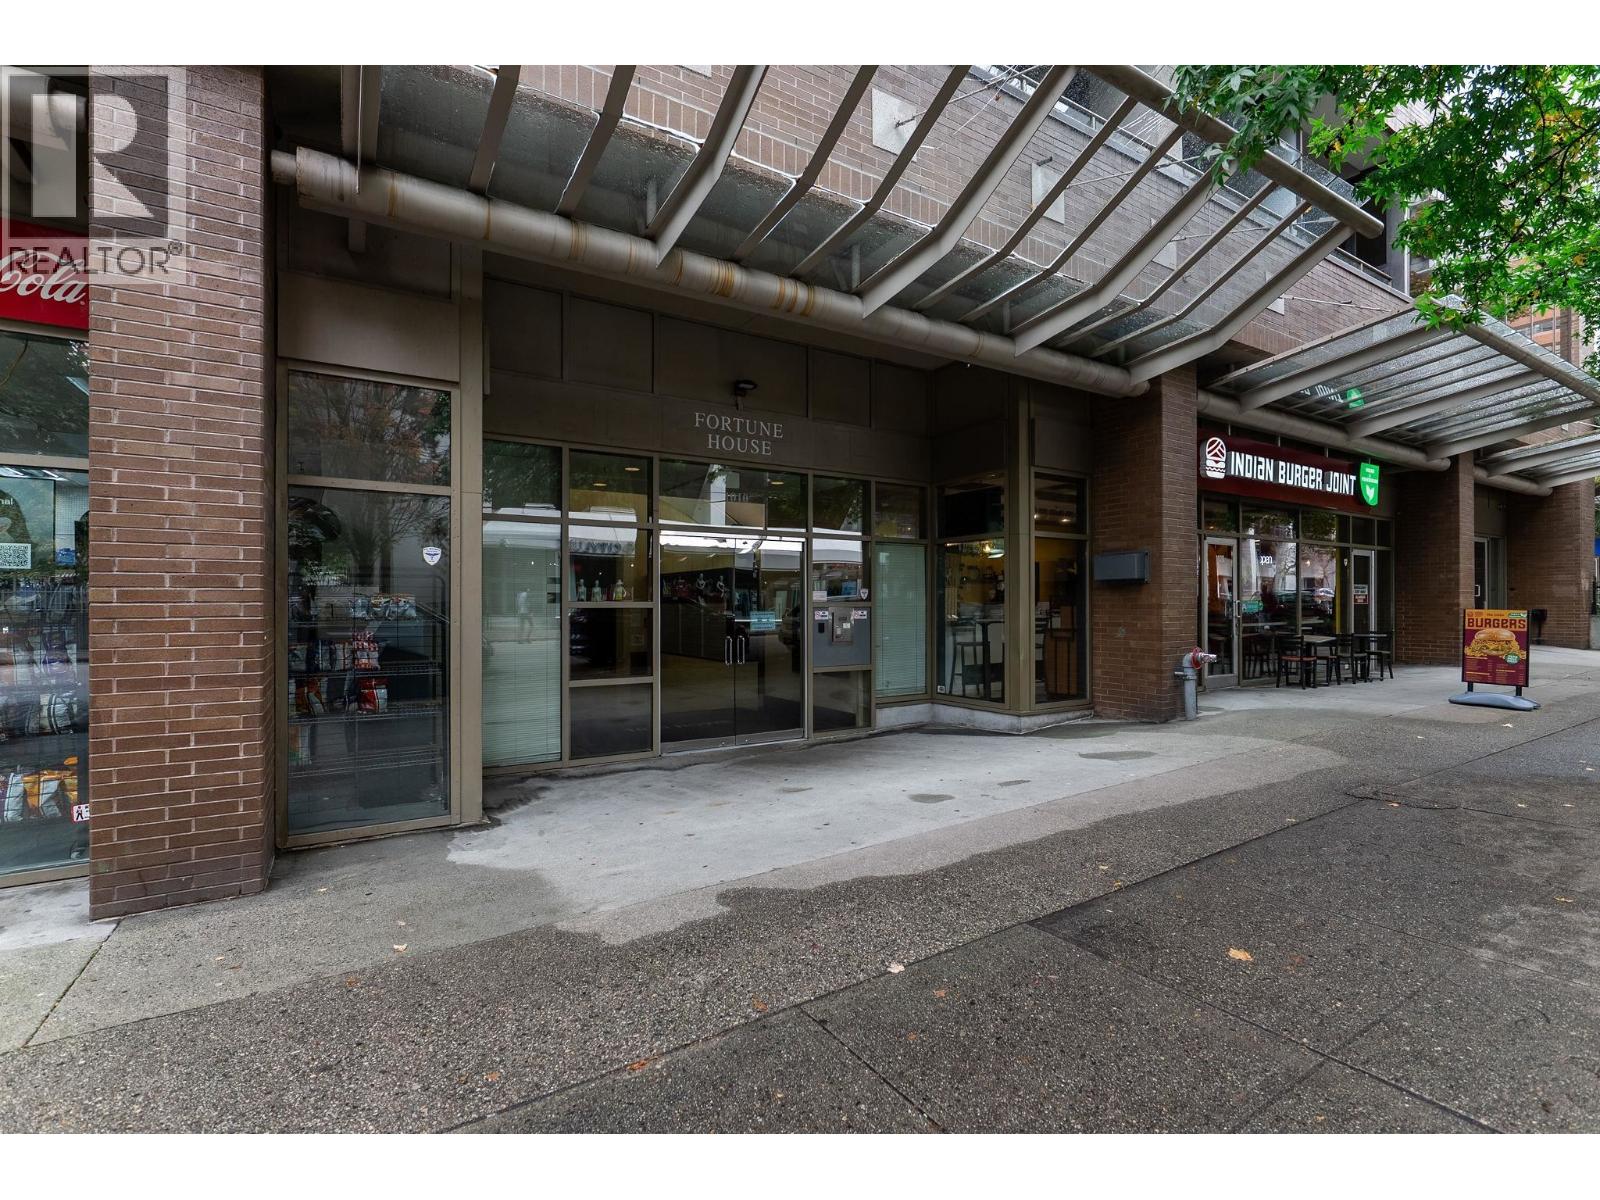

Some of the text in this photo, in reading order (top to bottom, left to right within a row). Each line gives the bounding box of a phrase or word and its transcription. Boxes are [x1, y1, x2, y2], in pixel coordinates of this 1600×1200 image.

[0, 249, 86, 304] Cola
[694, 412, 784, 439] FORTUNE
[707, 433, 772, 456] HOUSE
[1326, 471, 1357, 496] JOINT
